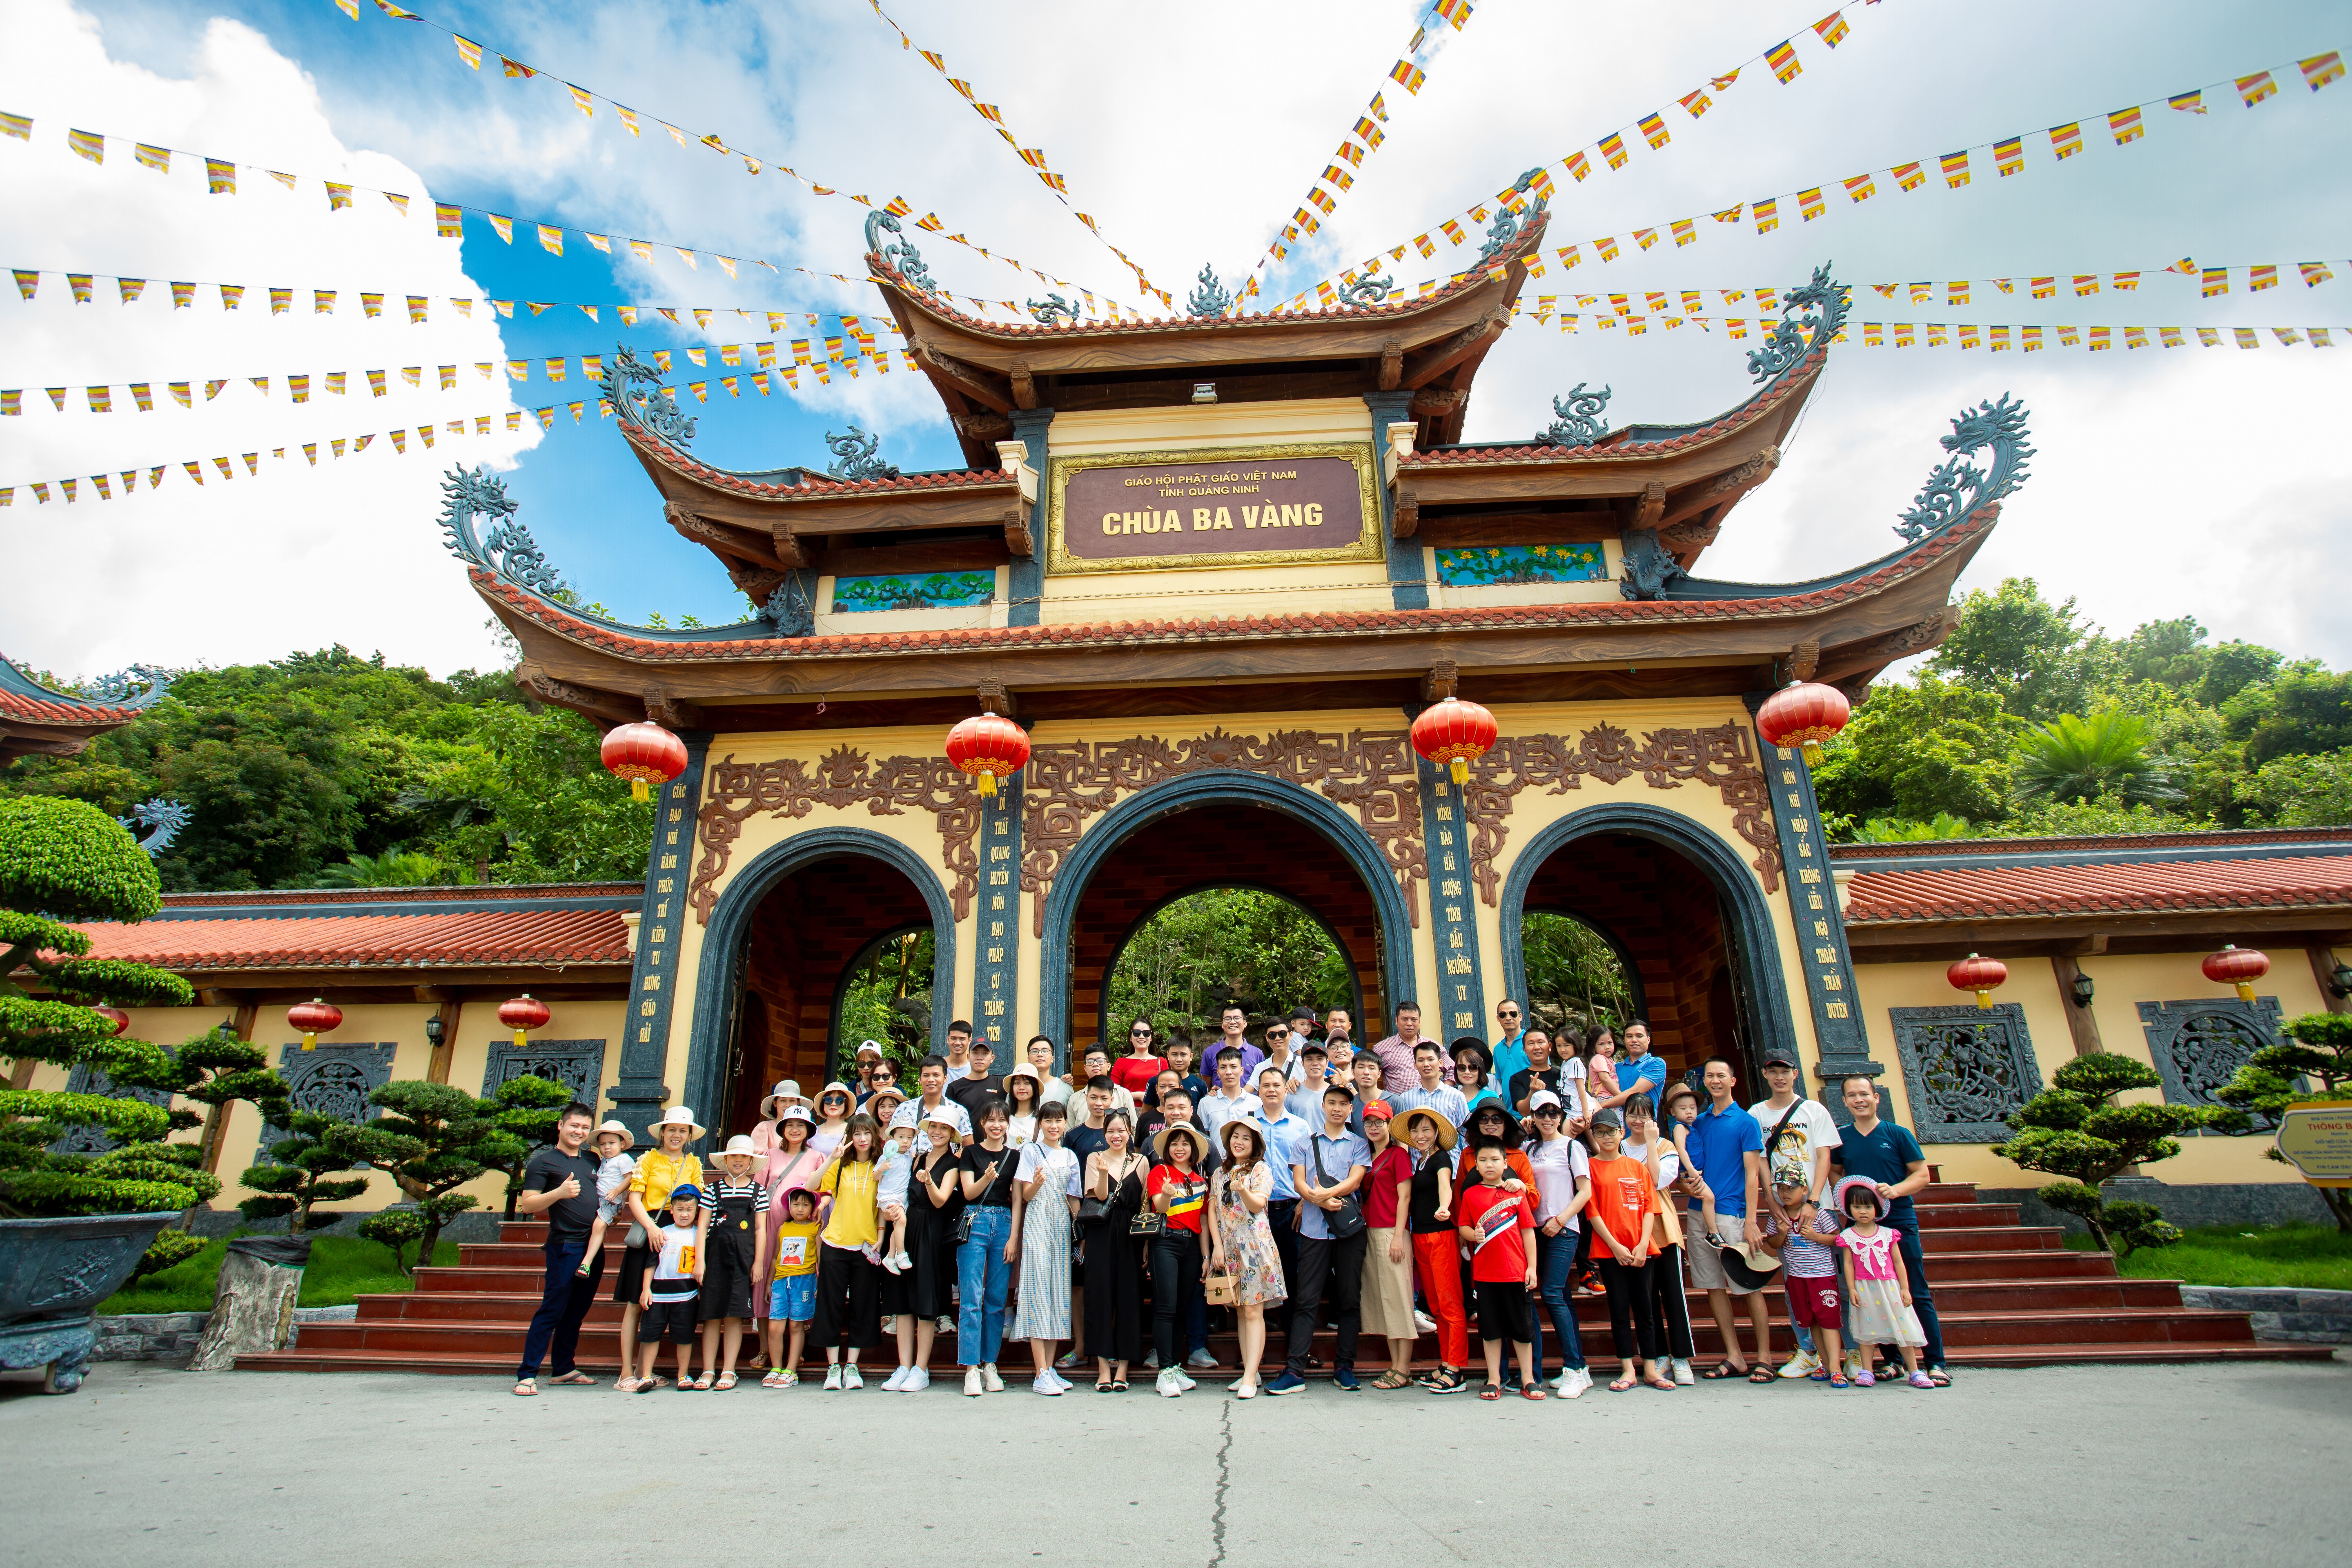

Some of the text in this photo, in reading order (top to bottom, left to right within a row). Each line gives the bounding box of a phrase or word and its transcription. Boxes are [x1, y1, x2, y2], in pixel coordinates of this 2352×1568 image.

[1125, 470, 1296, 486] GIÁO HỘI PHẬT GIÁO VIỆT NAM
[1159, 484, 1259, 497] TỈNH QUẢNG NINH
[1102, 499, 1323, 535] CHÙA BA VÀNG
[1782, 767, 1796, 784] MÔN
[673, 783, 686, 798] GIÁC
[1435, 780, 1448, 796] NHƯ
[668, 808, 682, 824] ĐẠO
[1437, 804, 1452, 821] MINH
[995, 817, 1008, 835] THÁI
[1791, 814, 1808, 836] NHẬP
[1440, 826, 1452, 845] BẢO
[991, 846, 1010, 863] QUANG
[1798, 836, 1811, 858] SẮC
[660, 852, 677, 869] HÀNH
[1443, 851, 1455, 871] HẢI
[990, 864, 1009, 885] HUYỀN
[1799, 865, 1821, 884] KHÔNG
[657, 877, 673, 893] PHÚC
[1442, 878, 1461, 898] LƯỢNG
[657, 898, 669, 918] TRÍ
[992, 892, 1004, 910] MÔN
[651, 925, 666, 942] KIÊM
[991, 922, 1003, 940] ĐẠO
[1814, 917, 1828, 940] NGỘ
[652, 951, 660, 965] TU
[989, 944, 1003, 962] PHÁP
[1815, 944, 1837, 964] THOÁT
[643, 973, 660, 991] HƯNG
[991, 972, 1000, 989] CƯ
[1823, 967, 1842, 991] TRẦN
[1457, 985, 1466, 1001] UY
[641, 998, 656, 1016] GIÁO
[985, 992, 1004, 1016] THẮNG
[1826, 998, 1848, 1018] DUYÊN
[987, 1018, 1000, 1041] TÍCH
[1455, 1013, 1473, 1028] DANH
[639, 1022, 651, 1042] HẢI
[2307, 1122, 2342, 1130] THÔNG
[1483, 1214, 1503, 1231] ENDI
